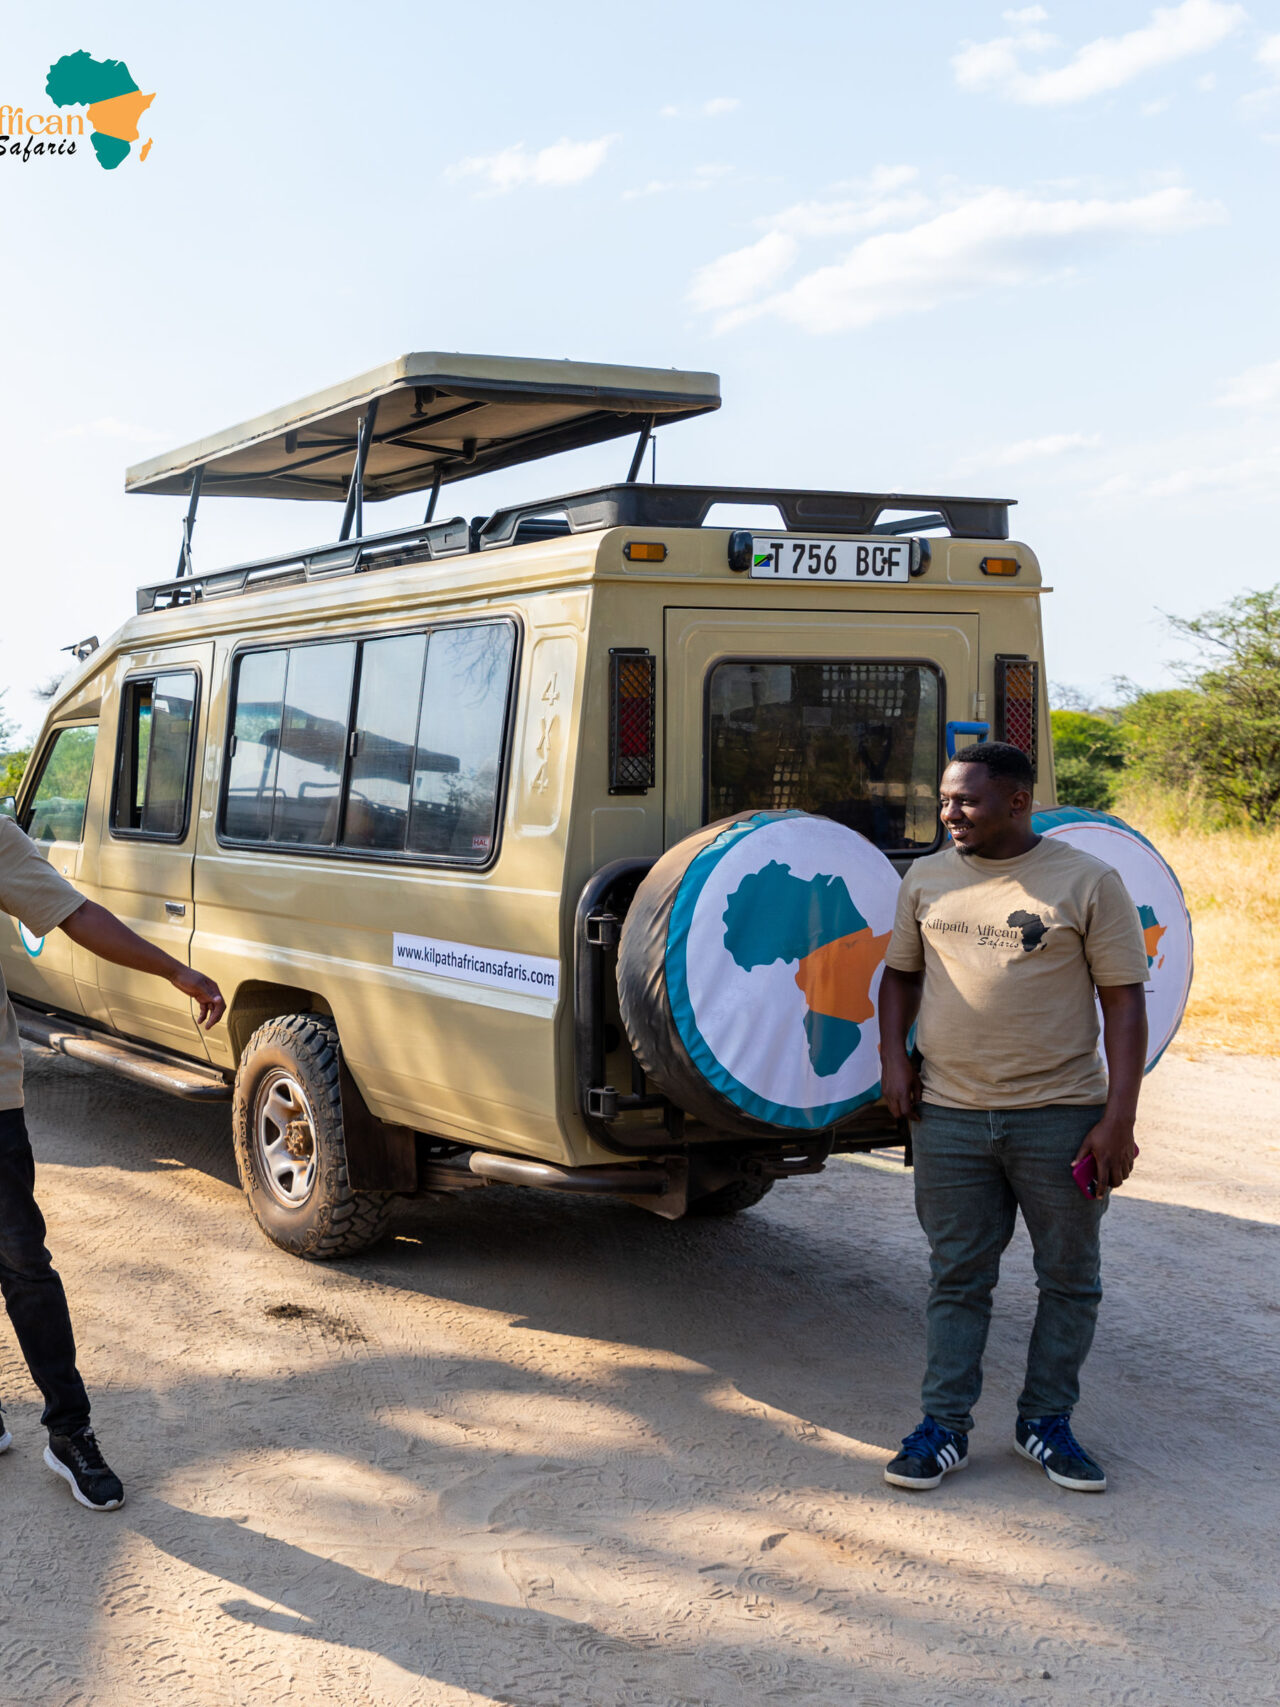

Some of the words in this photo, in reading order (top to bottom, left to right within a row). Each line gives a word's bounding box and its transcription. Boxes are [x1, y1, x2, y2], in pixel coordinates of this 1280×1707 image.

[770, 543, 784, 573] T
[792, 543, 837, 575] 756
[856, 545, 901, 577] BCF
[976, 924, 1018, 939] African
[977, 936, 1019, 949] Safaris
[397, 946, 554, 986] www.kilpathafricansafaris.com
